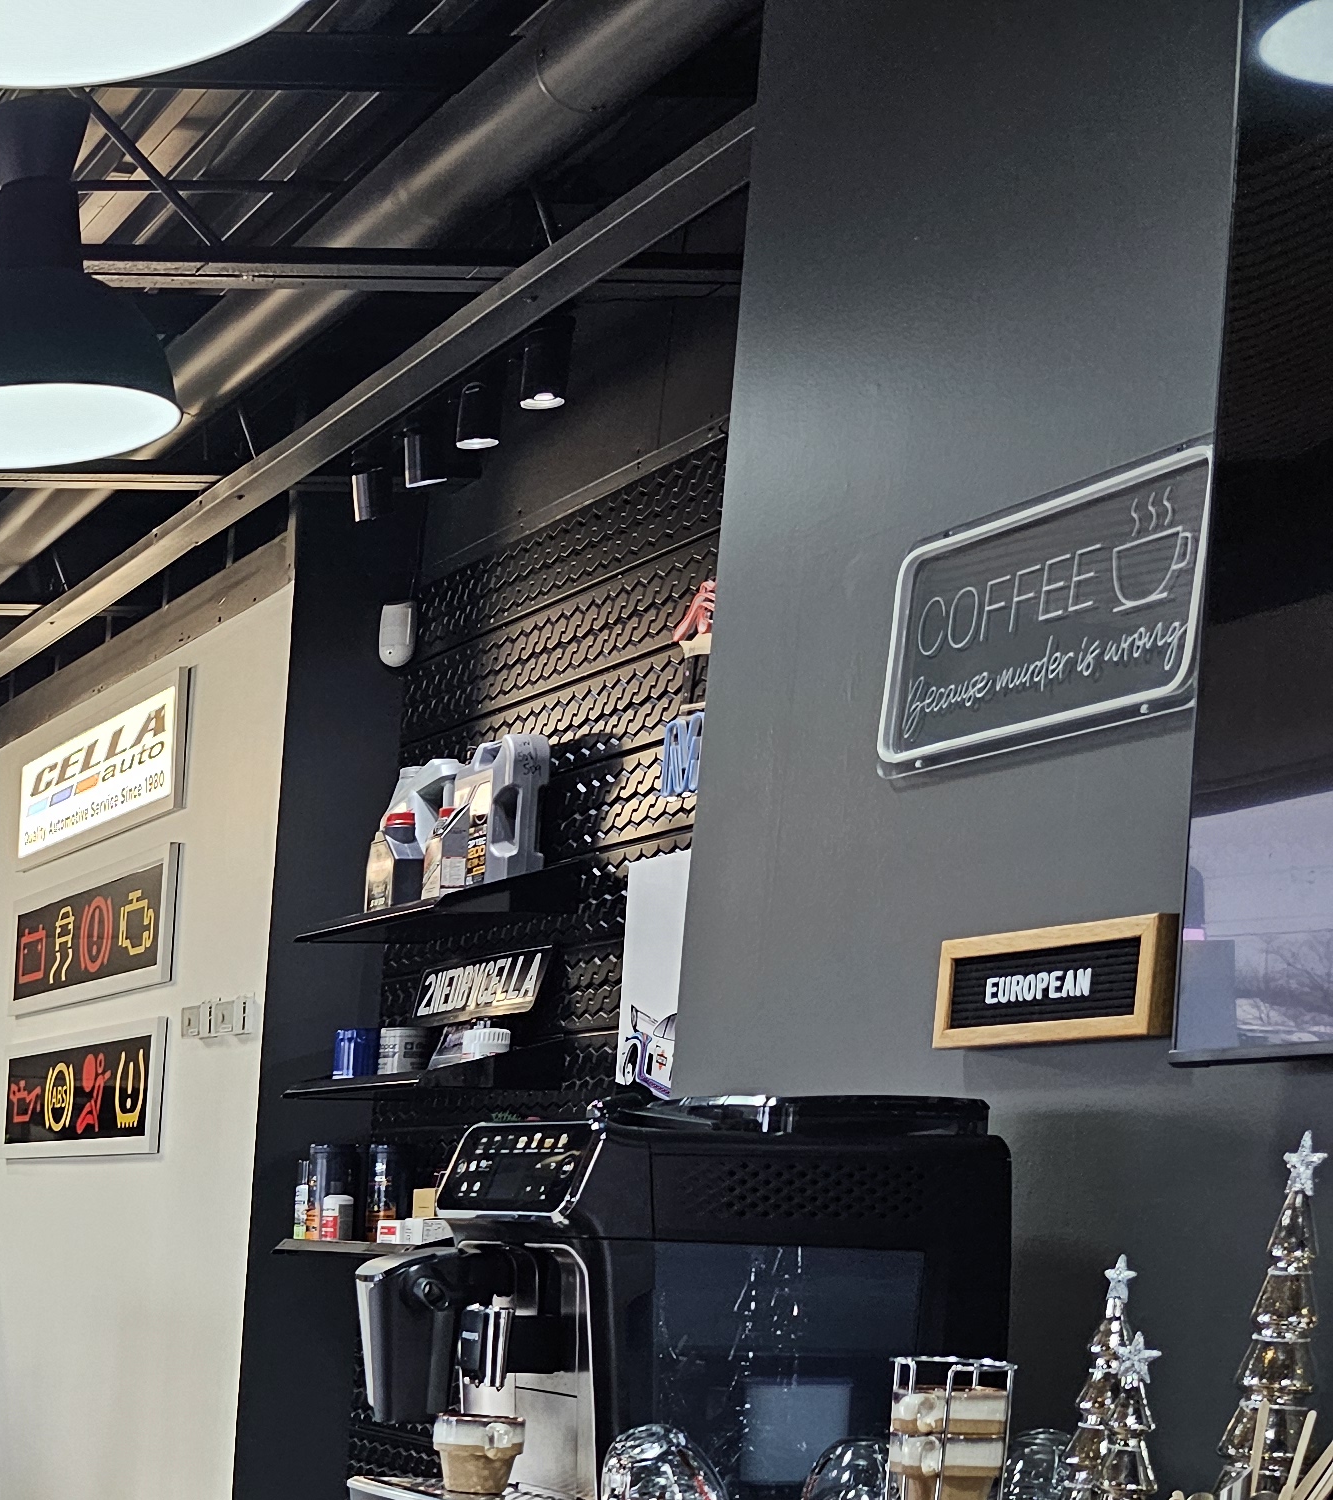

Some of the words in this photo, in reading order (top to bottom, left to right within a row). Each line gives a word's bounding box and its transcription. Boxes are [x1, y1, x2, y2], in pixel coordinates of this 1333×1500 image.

[918, 543, 1102, 656] COFFEE
[902, 671, 993, 738] Because
[996, 635, 1074, 691] murder
[1077, 636, 1101, 676] is
[1103, 620, 1189, 670] wrong
[30, 703, 167, 797] CELLA
[101, 741, 165, 783] auto
[48, 805, 89, 835] Automotive
[90, 793, 120, 818] Service
[120, 783, 143, 805] Since
[144, 770, 165, 794] 1980
[984, 967, 1093, 1005] EUROPEAN
[50, 1085, 68, 1109] ABS
